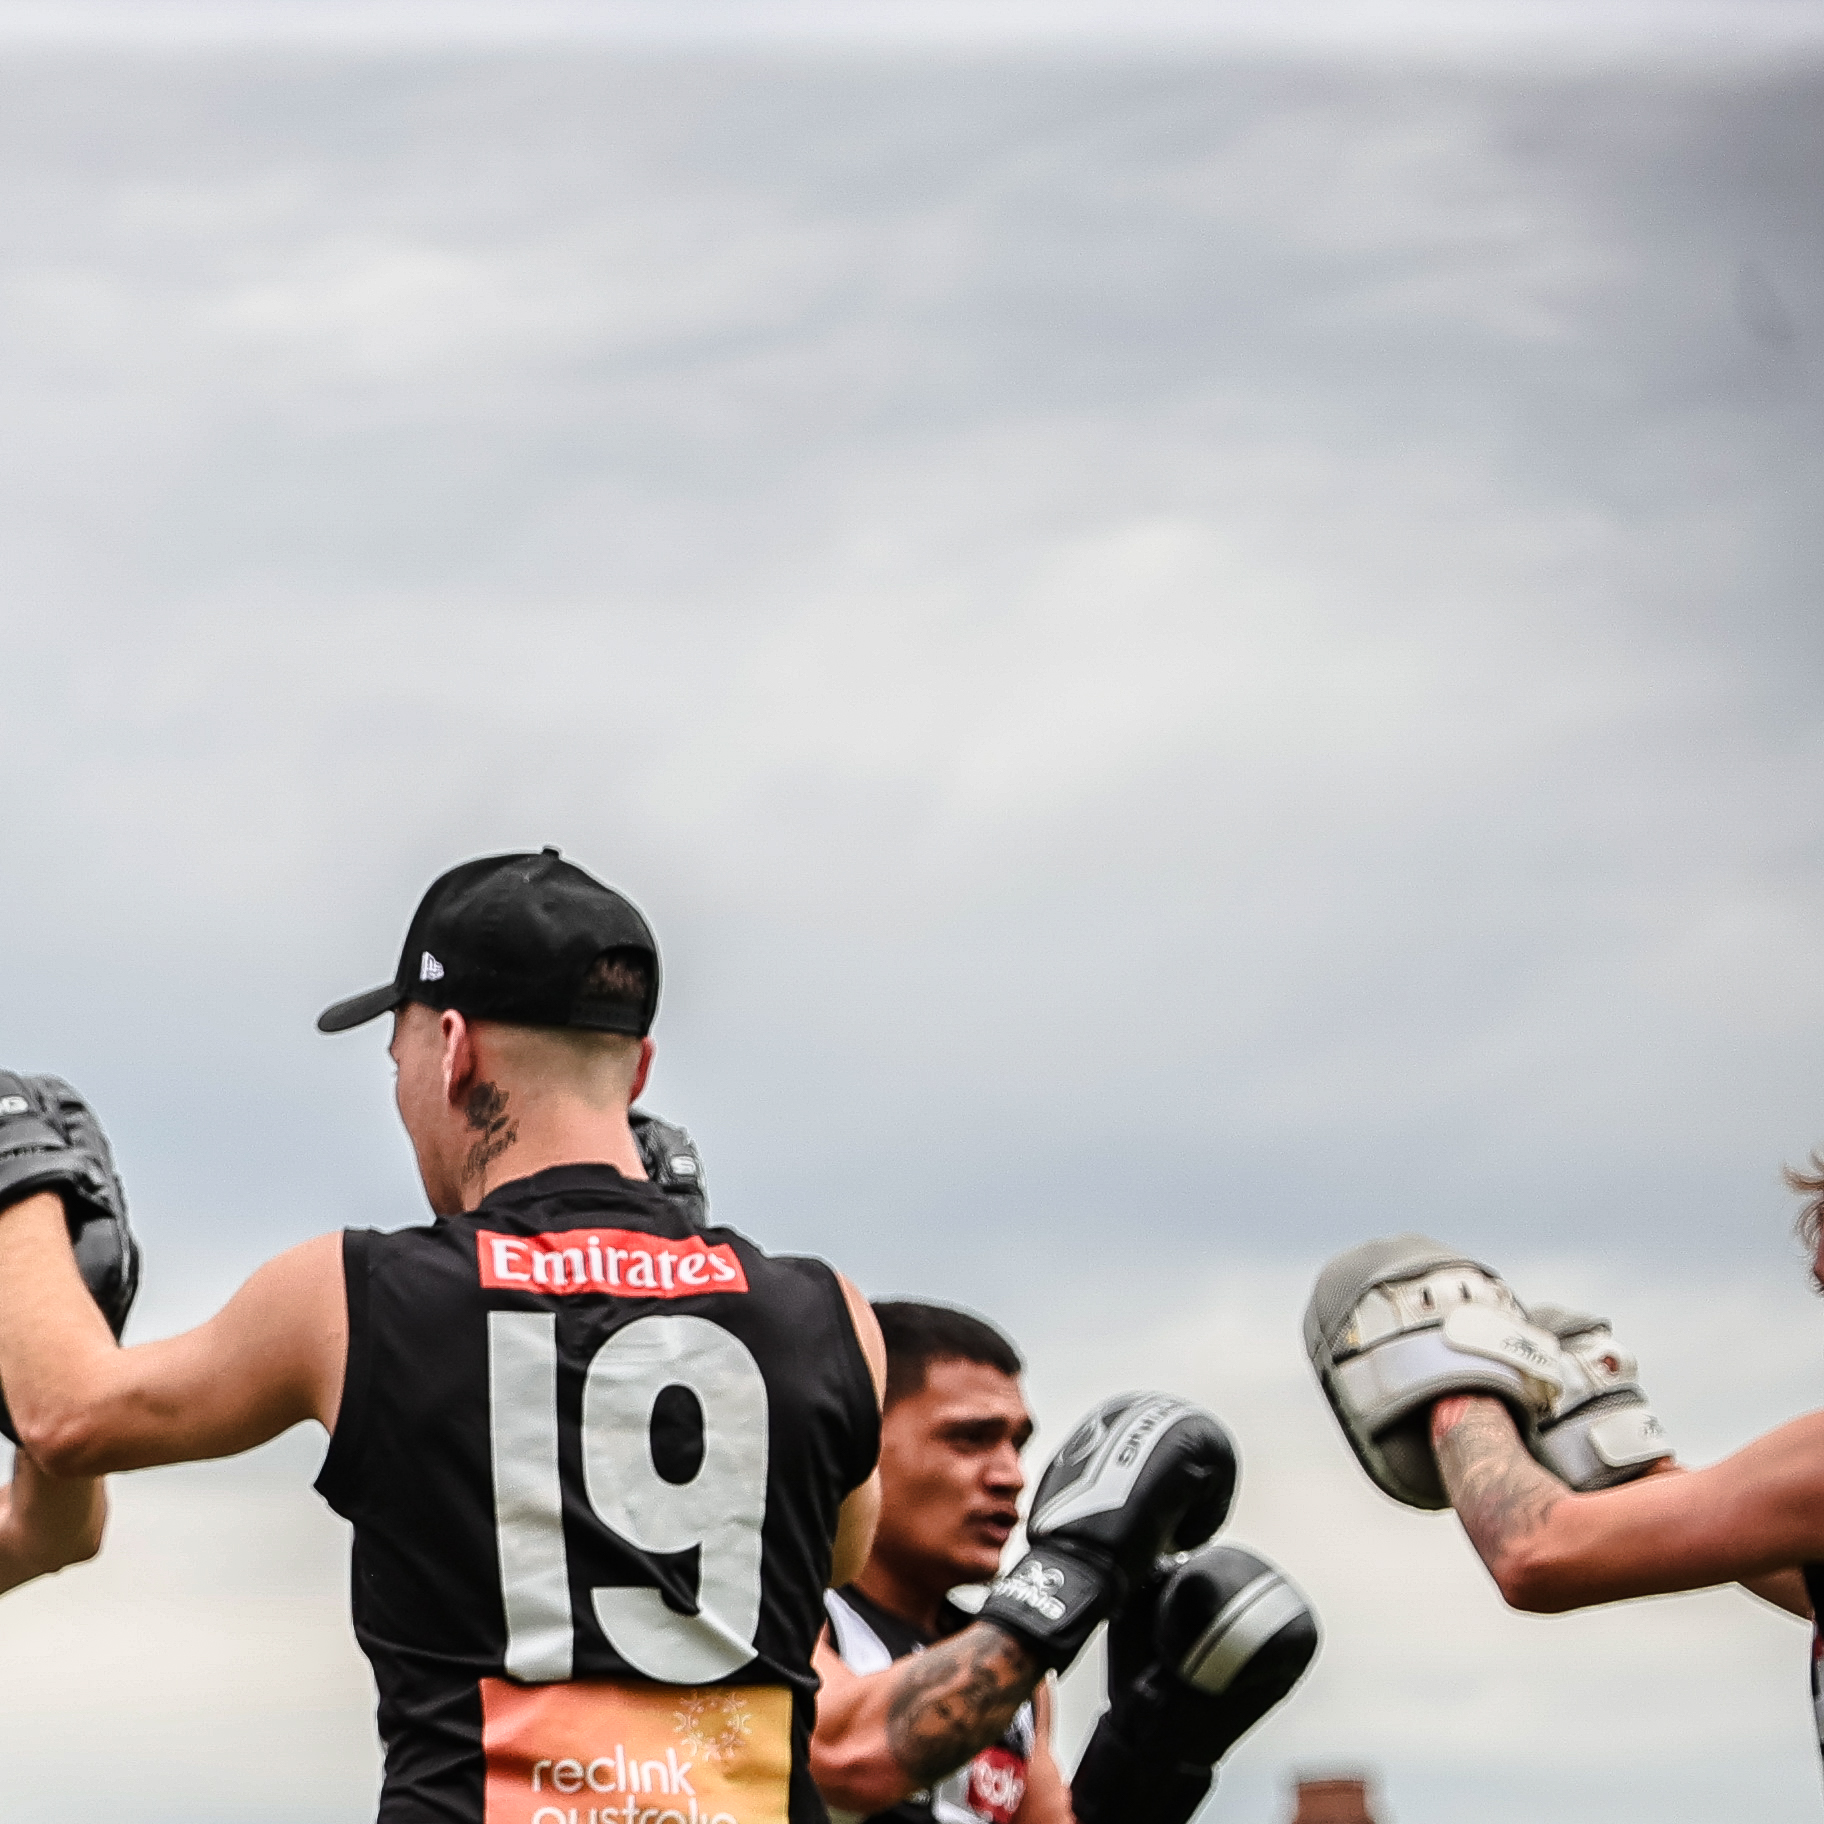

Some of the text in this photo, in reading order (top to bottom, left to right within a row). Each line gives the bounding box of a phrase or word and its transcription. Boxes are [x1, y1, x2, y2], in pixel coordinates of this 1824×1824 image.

[490, 1236, 737, 1290] Emirates
[487, 1310, 769, 1686] 19
[531, 1745, 695, 1796] reclink
